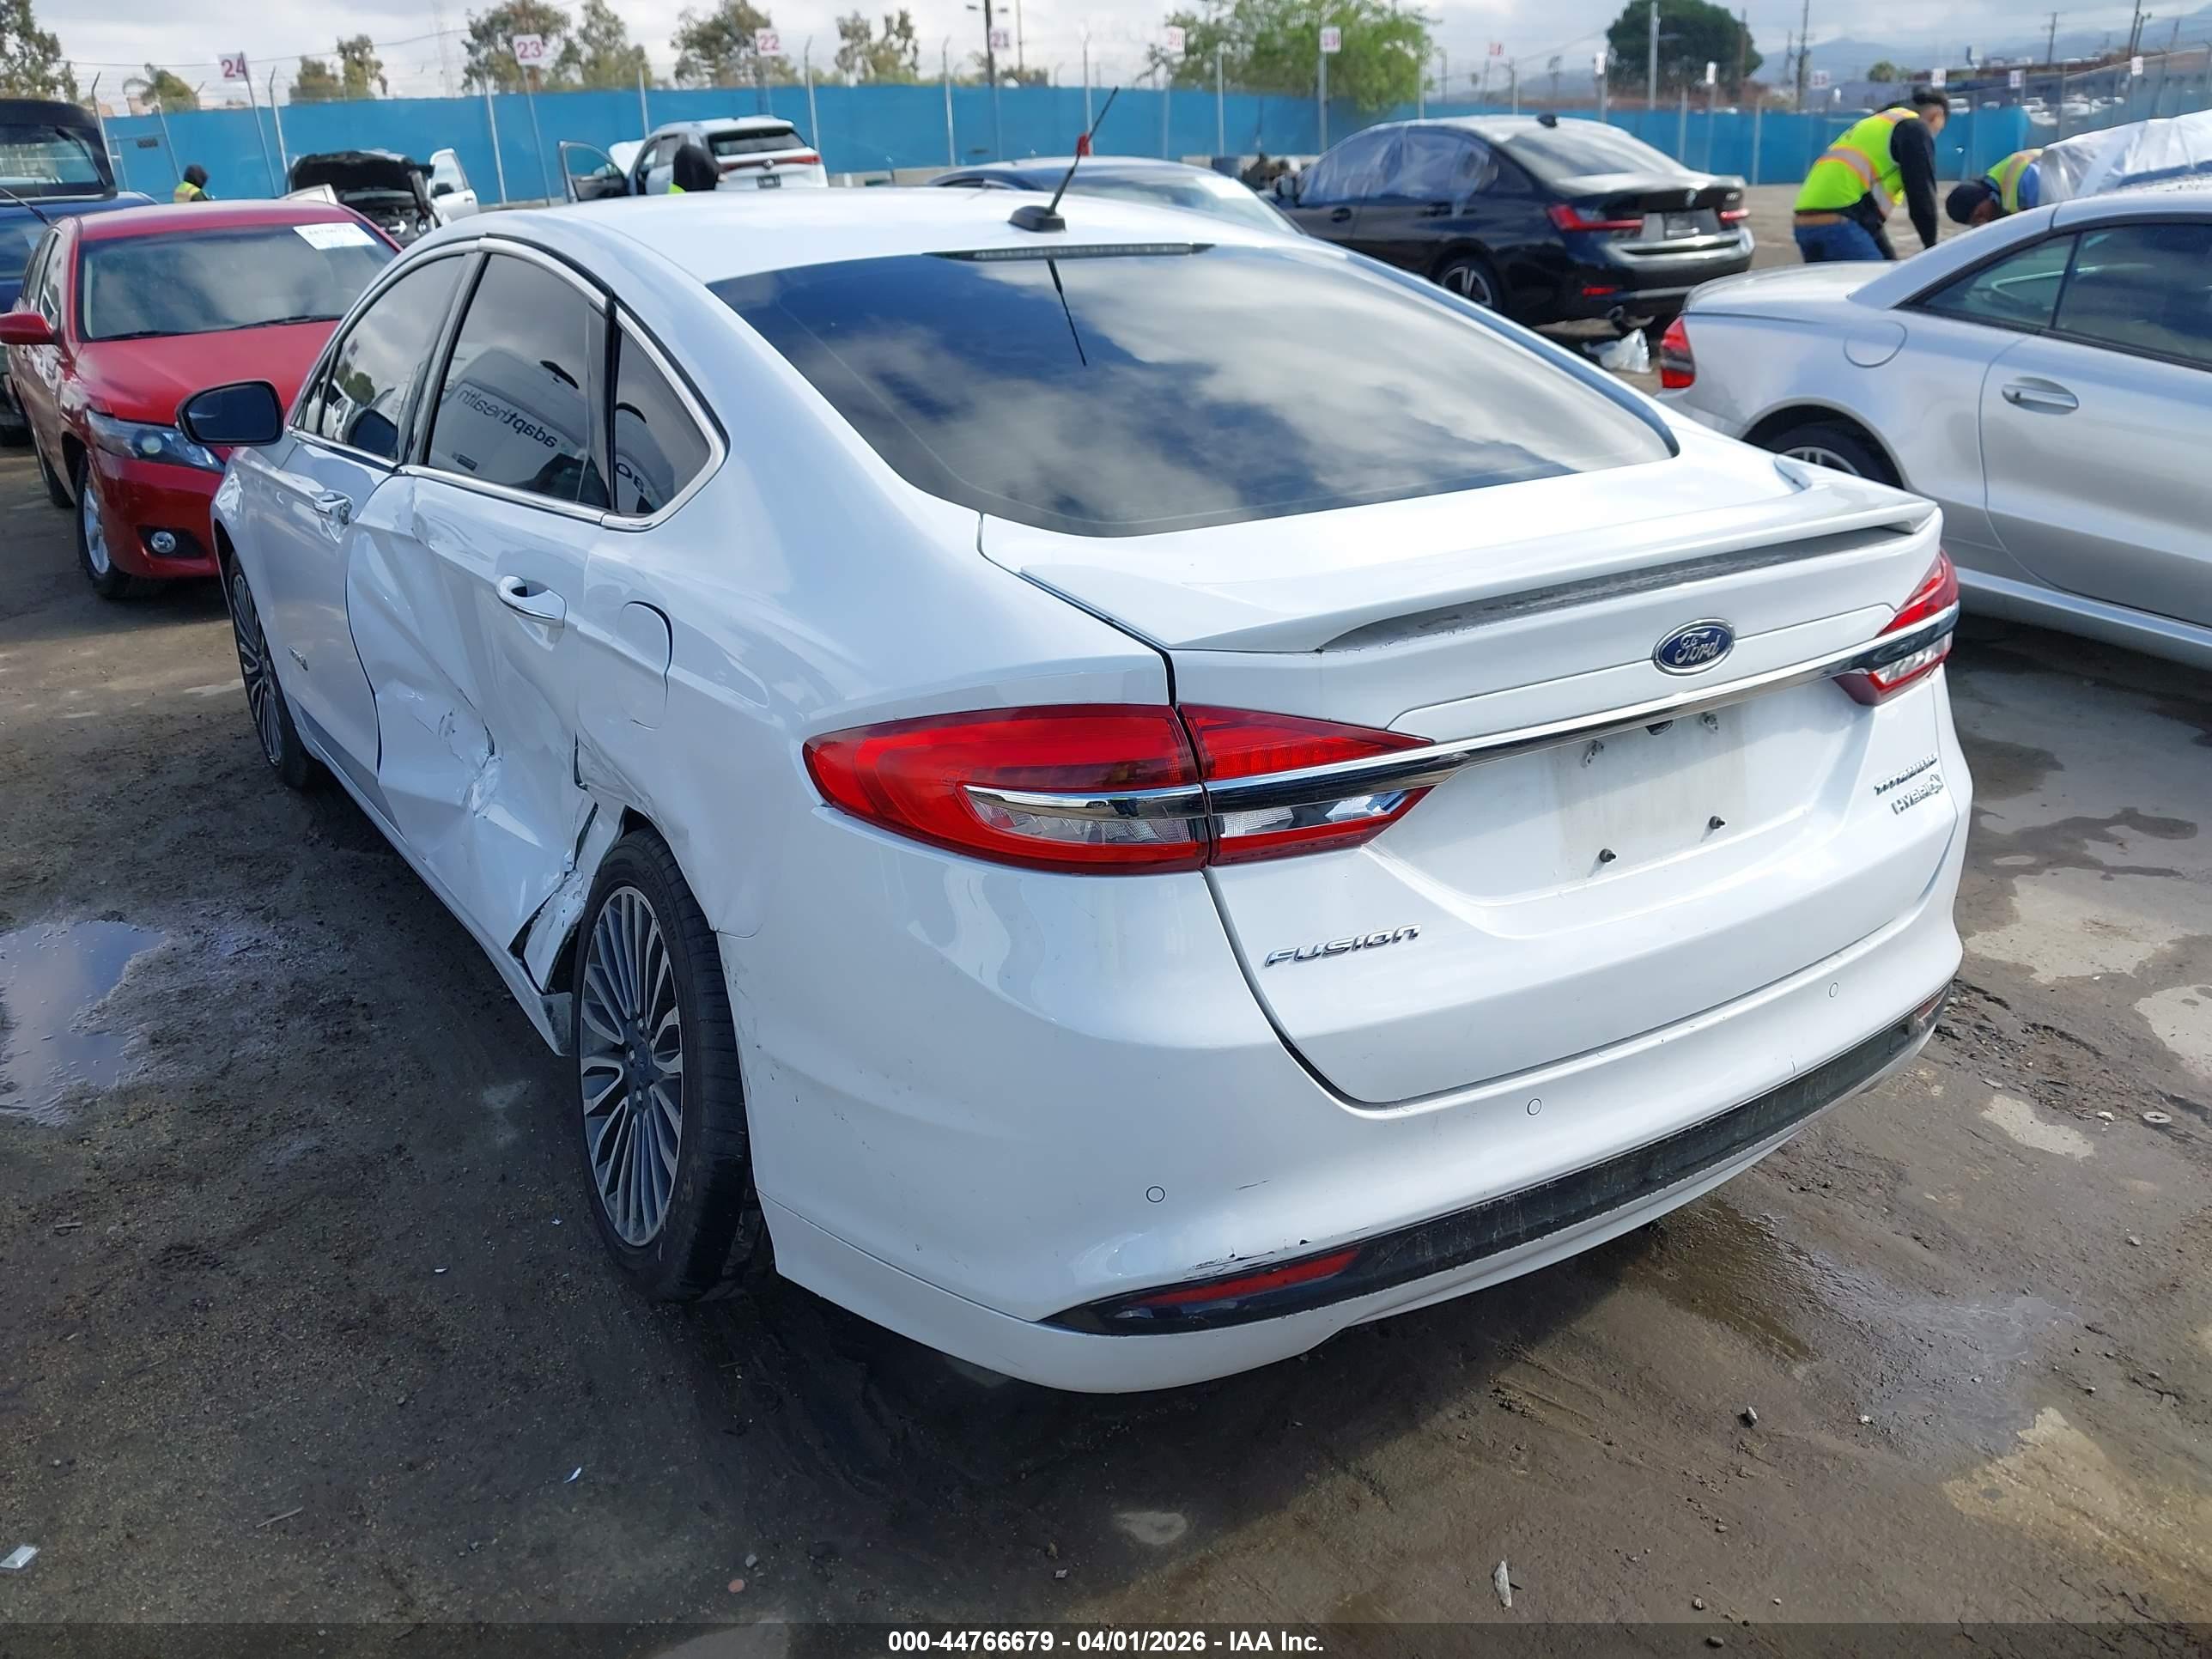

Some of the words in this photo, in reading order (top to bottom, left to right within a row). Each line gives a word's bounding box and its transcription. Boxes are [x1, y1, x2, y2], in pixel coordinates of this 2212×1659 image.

[517, 41, 543, 59] 23
[759, 34, 780, 51] 22
[221, 58, 247, 78] 24
[1674, 630, 1722, 665] Ford
[1263, 923, 1422, 969] FUSION
